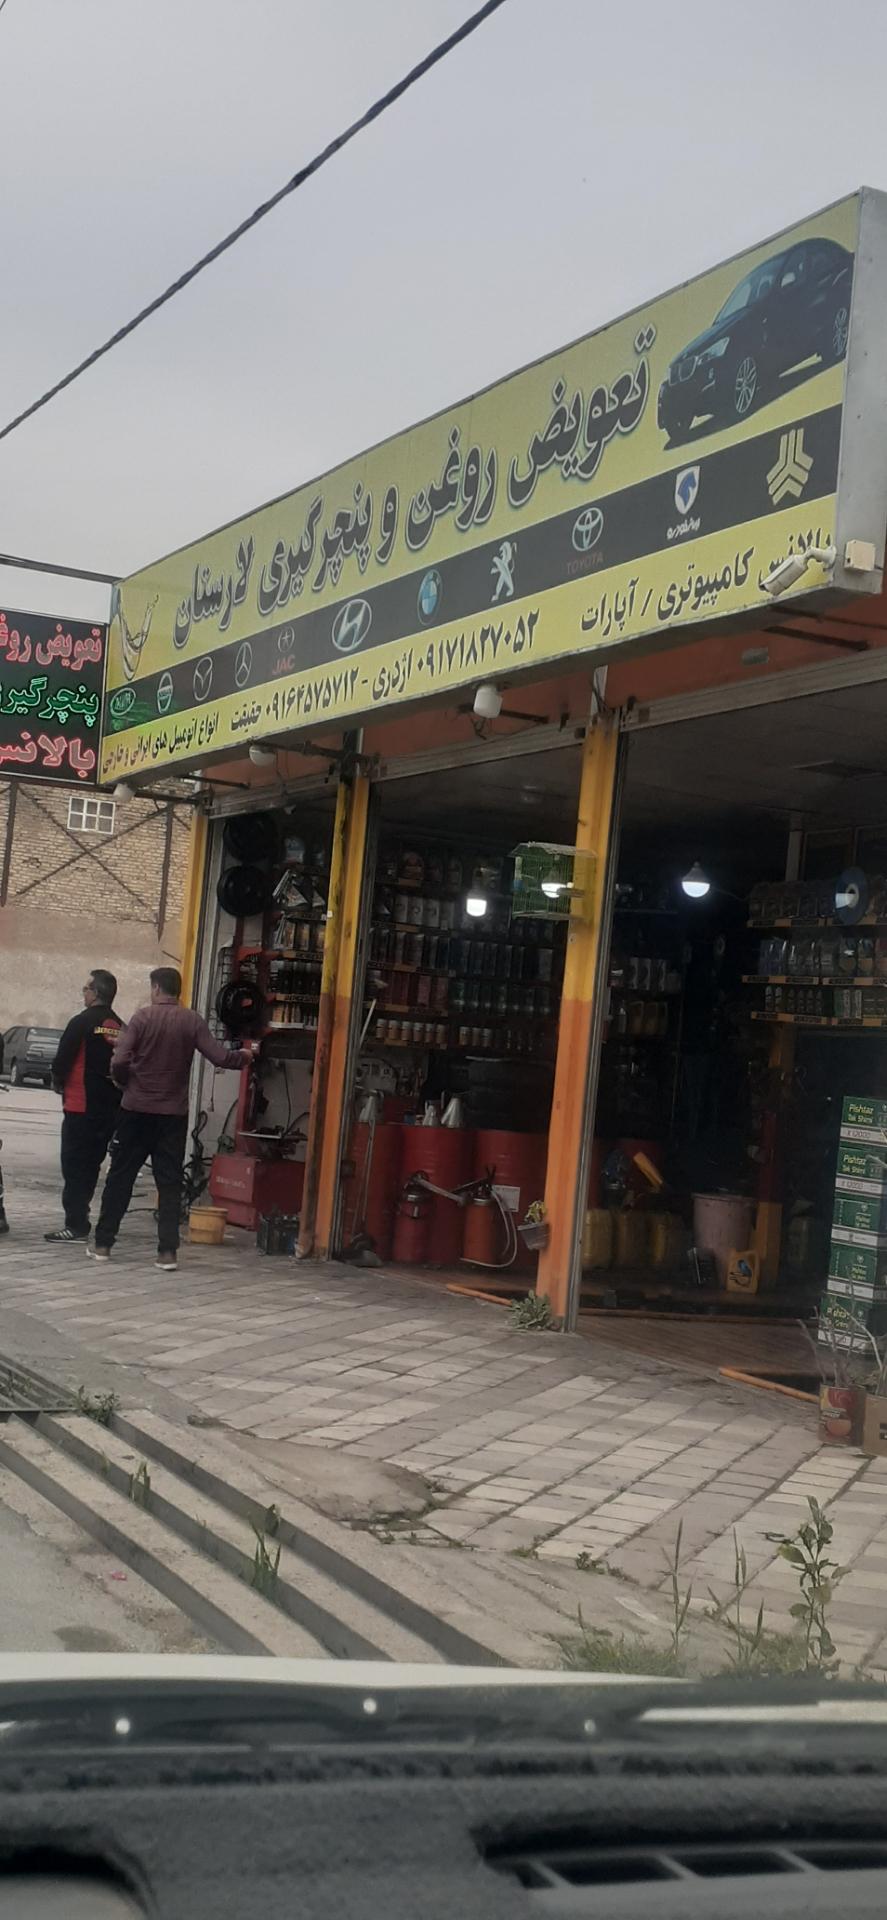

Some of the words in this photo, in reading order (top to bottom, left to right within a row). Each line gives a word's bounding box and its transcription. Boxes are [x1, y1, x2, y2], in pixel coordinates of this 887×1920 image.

[507, 322, 657, 507] تعویض
[405, 425, 498, 550] روغن
[376, 484, 399, 564] و
[566, 552, 604, 575] TOYOTA
[656, 546, 755, 621] کامپیوتری
[173, 535, 255, 648] لارستان
[581, 577, 640, 636] آپارات
[0, 613, 32, 662] روغ
[36, 623, 102, 670] تعویض
[417, 608, 540, 677] ۰۹۱۷۱۸۲۷۰۵۲
[272, 655, 296, 676] JAC
[372, 648, 413, 700] اژدری
[0, 677, 99, 727] پنچرگیر
[231, 701, 262, 733] حقیقت
[266, 666, 359, 720] ۰۹۱۶۴۵۷۵۷۱۲
[130, 732, 152, 766] ایرانی
[152, 730, 168, 759] های
[169, 718, 197, 754] اتومبیل
[198, 711, 220, 746] انواع
[103, 743, 124, 774] خارجی
[124, 747, 129, 767] و
